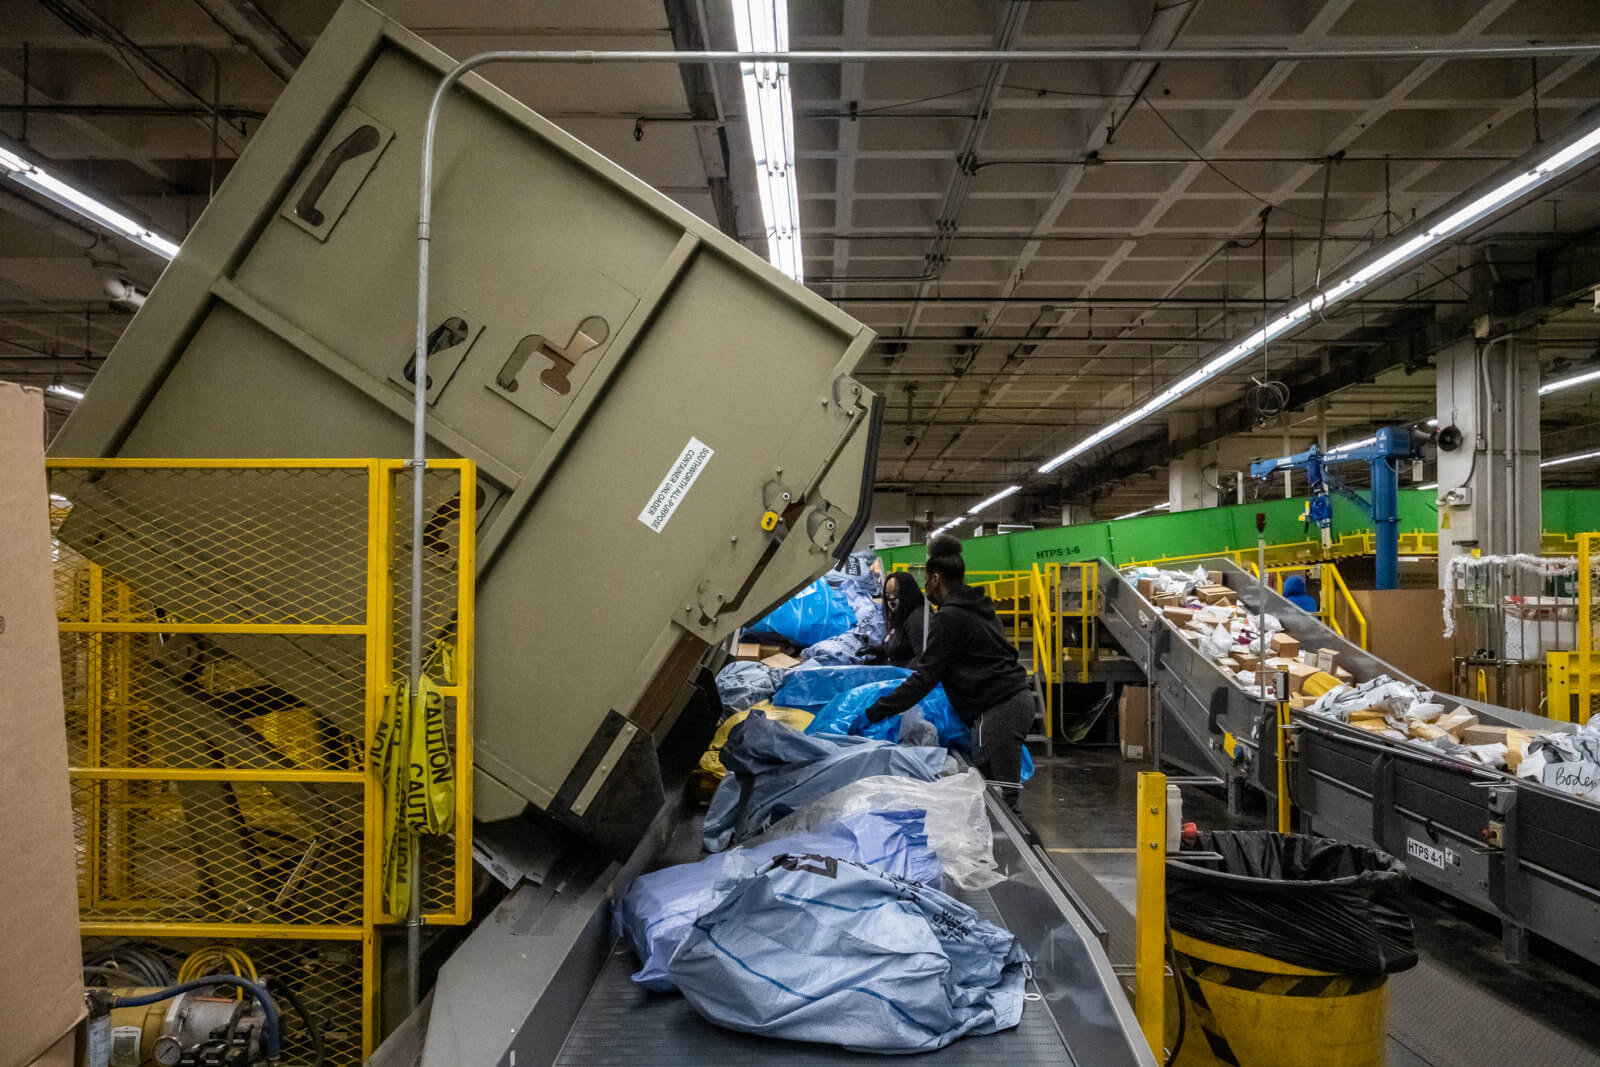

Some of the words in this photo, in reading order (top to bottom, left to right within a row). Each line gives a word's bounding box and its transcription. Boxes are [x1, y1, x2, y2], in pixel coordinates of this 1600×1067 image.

[669, 449, 695, 483] CONTAINER
[679, 447, 709, 489] SOUTHWORTH
[648, 482, 674, 516] UNLOADER
[651, 487, 682, 529] ALL-PURPOSE
[1036, 547, 1064, 559] HTPS
[426, 691, 453, 785] CAUTION
[1408, 840, 1429, 860] HTPS
[1431, 852, 1443, 866] 4-1
